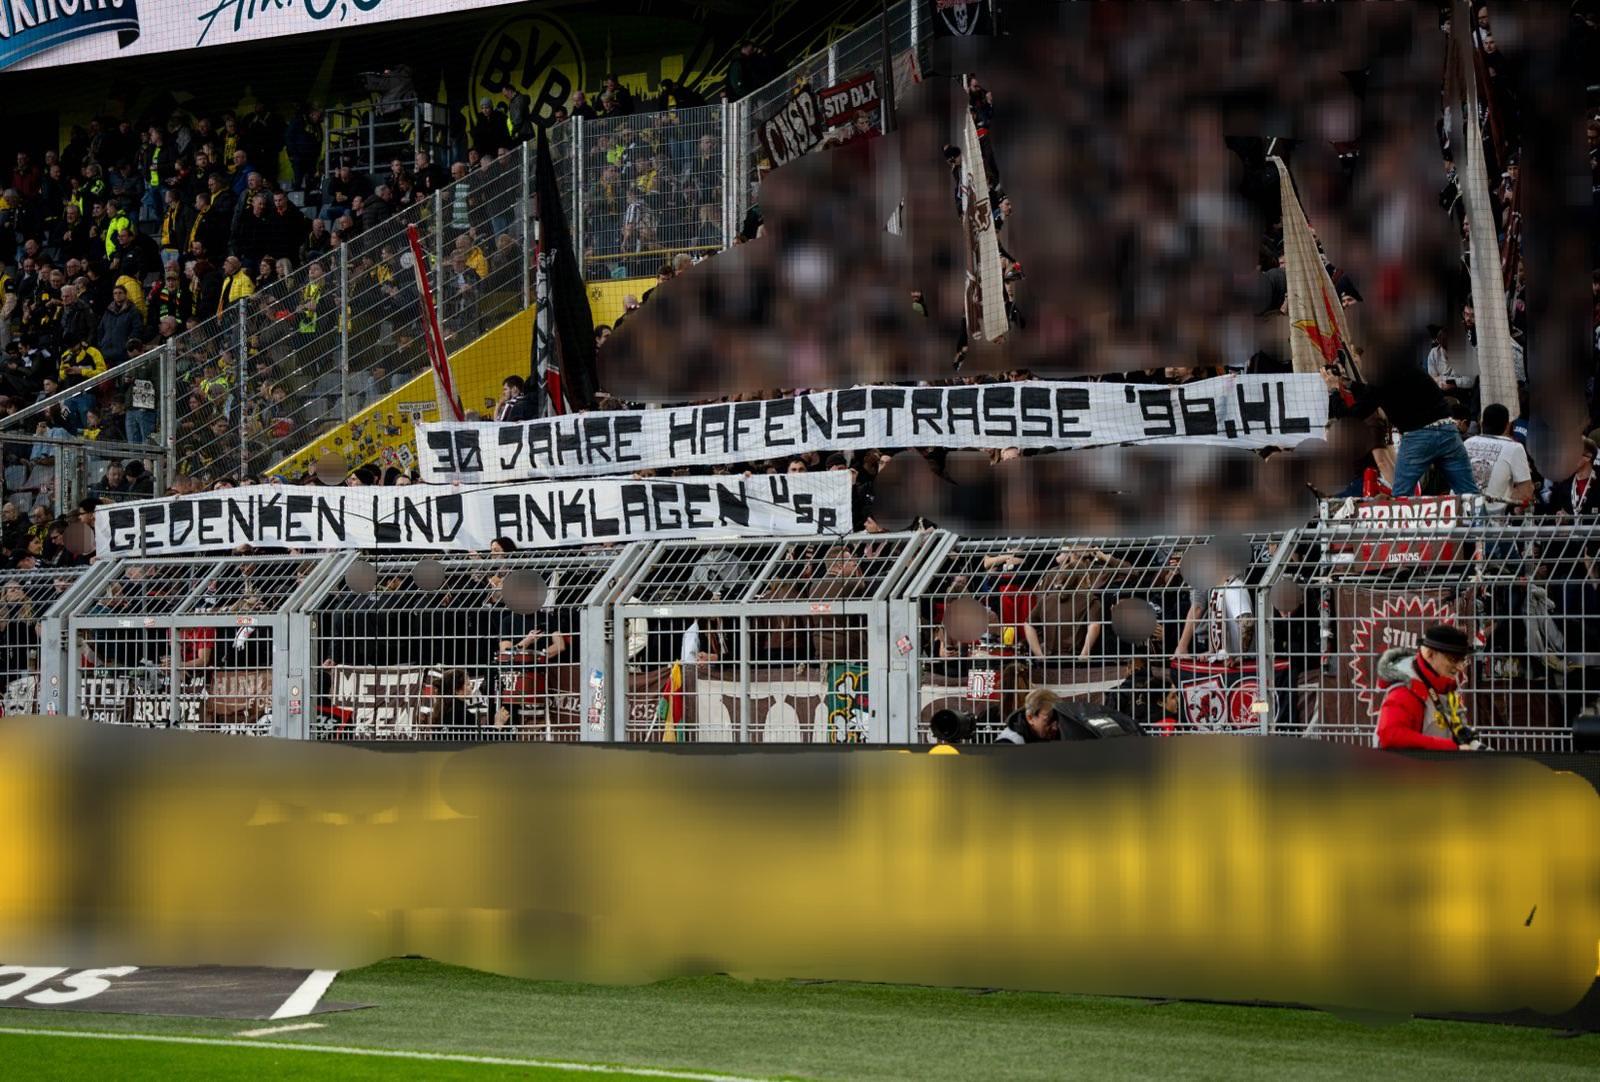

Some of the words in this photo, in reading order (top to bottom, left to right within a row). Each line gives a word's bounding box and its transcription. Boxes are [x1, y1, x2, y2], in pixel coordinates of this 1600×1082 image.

[823, 92, 849, 118] STP
[850, 80, 878, 107] DLX
[427, 429, 484, 472] 30
[499, 415, 642, 470] JAHRE
[669, 387, 1092, 458] HAFENSTRASSE
[109, 493, 346, 551] GEDENKEN
[373, 494, 463, 543] UND
[494, 481, 750, 542] ANKLAGEN
[1382, 626, 1418, 649] STILL
[338, 671, 421, 703] METT
